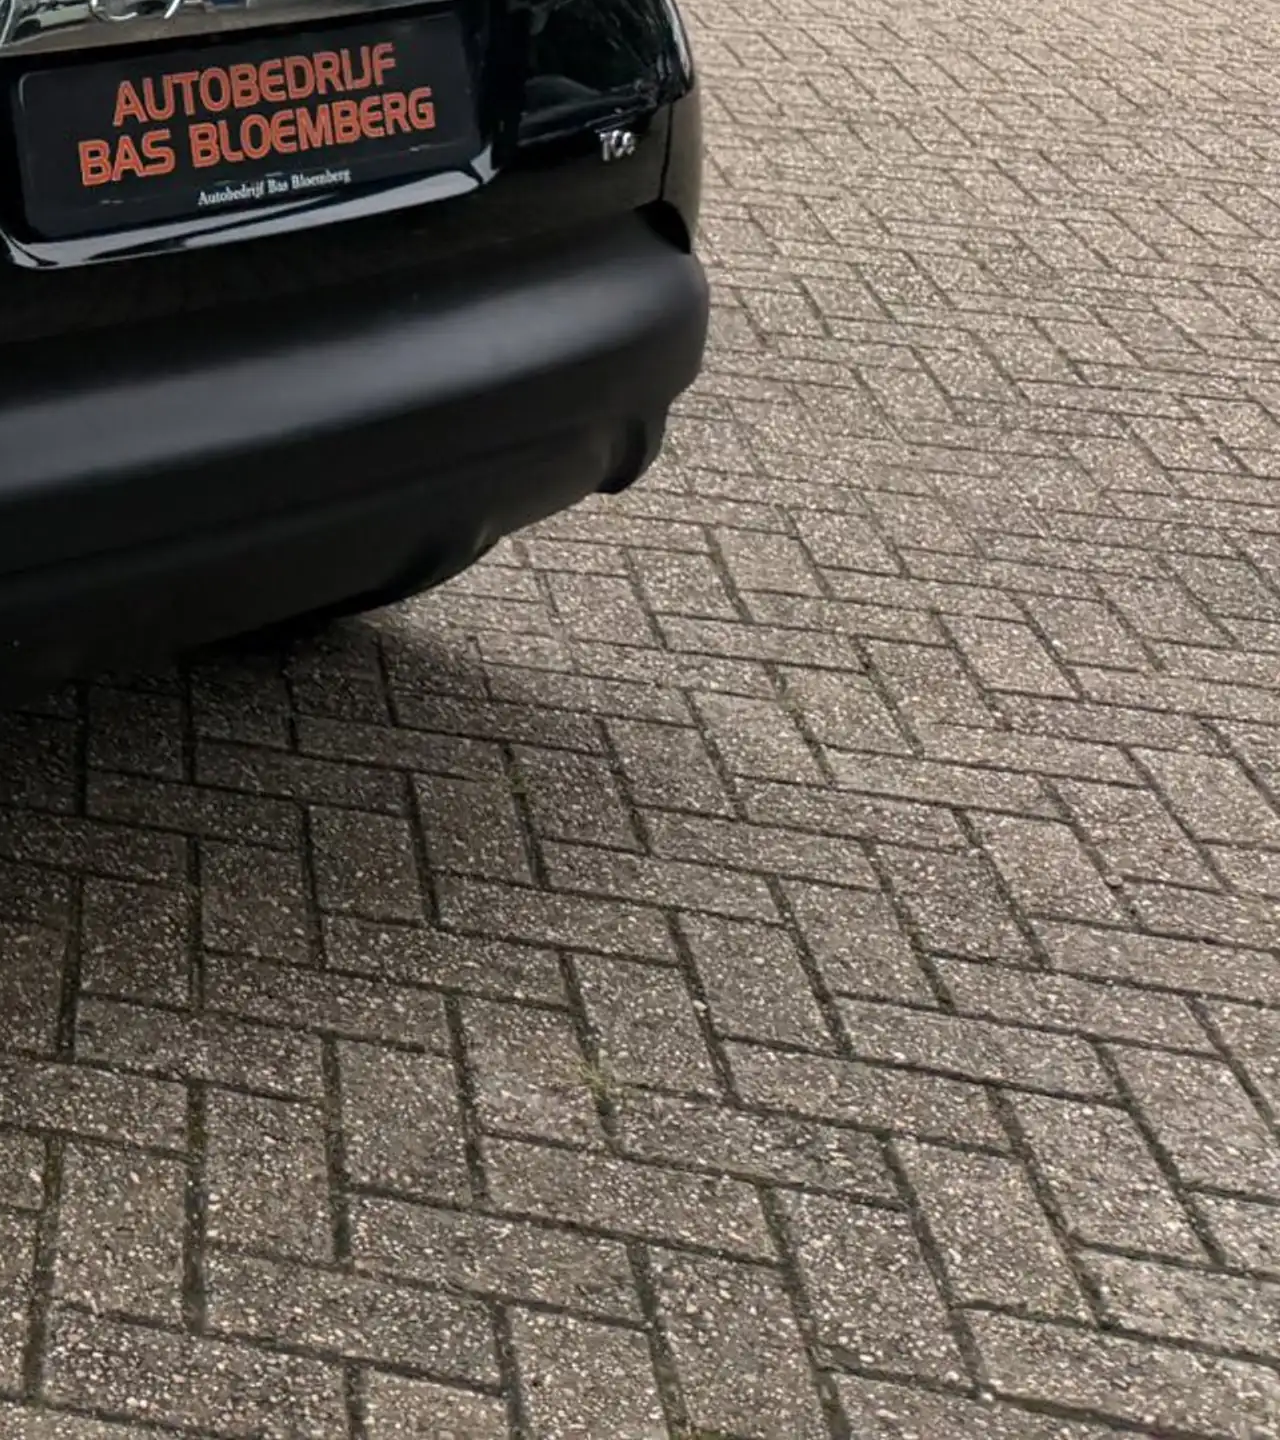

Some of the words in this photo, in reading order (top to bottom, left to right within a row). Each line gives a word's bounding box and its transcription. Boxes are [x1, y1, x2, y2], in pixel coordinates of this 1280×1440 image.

[112, 42, 398, 127] AUTOBEDRIJF
[77, 129, 176, 187] BAS
[188, 86, 436, 170] BLOEMBERG
[196, 178, 266, 208] Autobedrijf
[266, 176, 290, 196] Bas
[290, 167, 353, 191] Bloemberg
